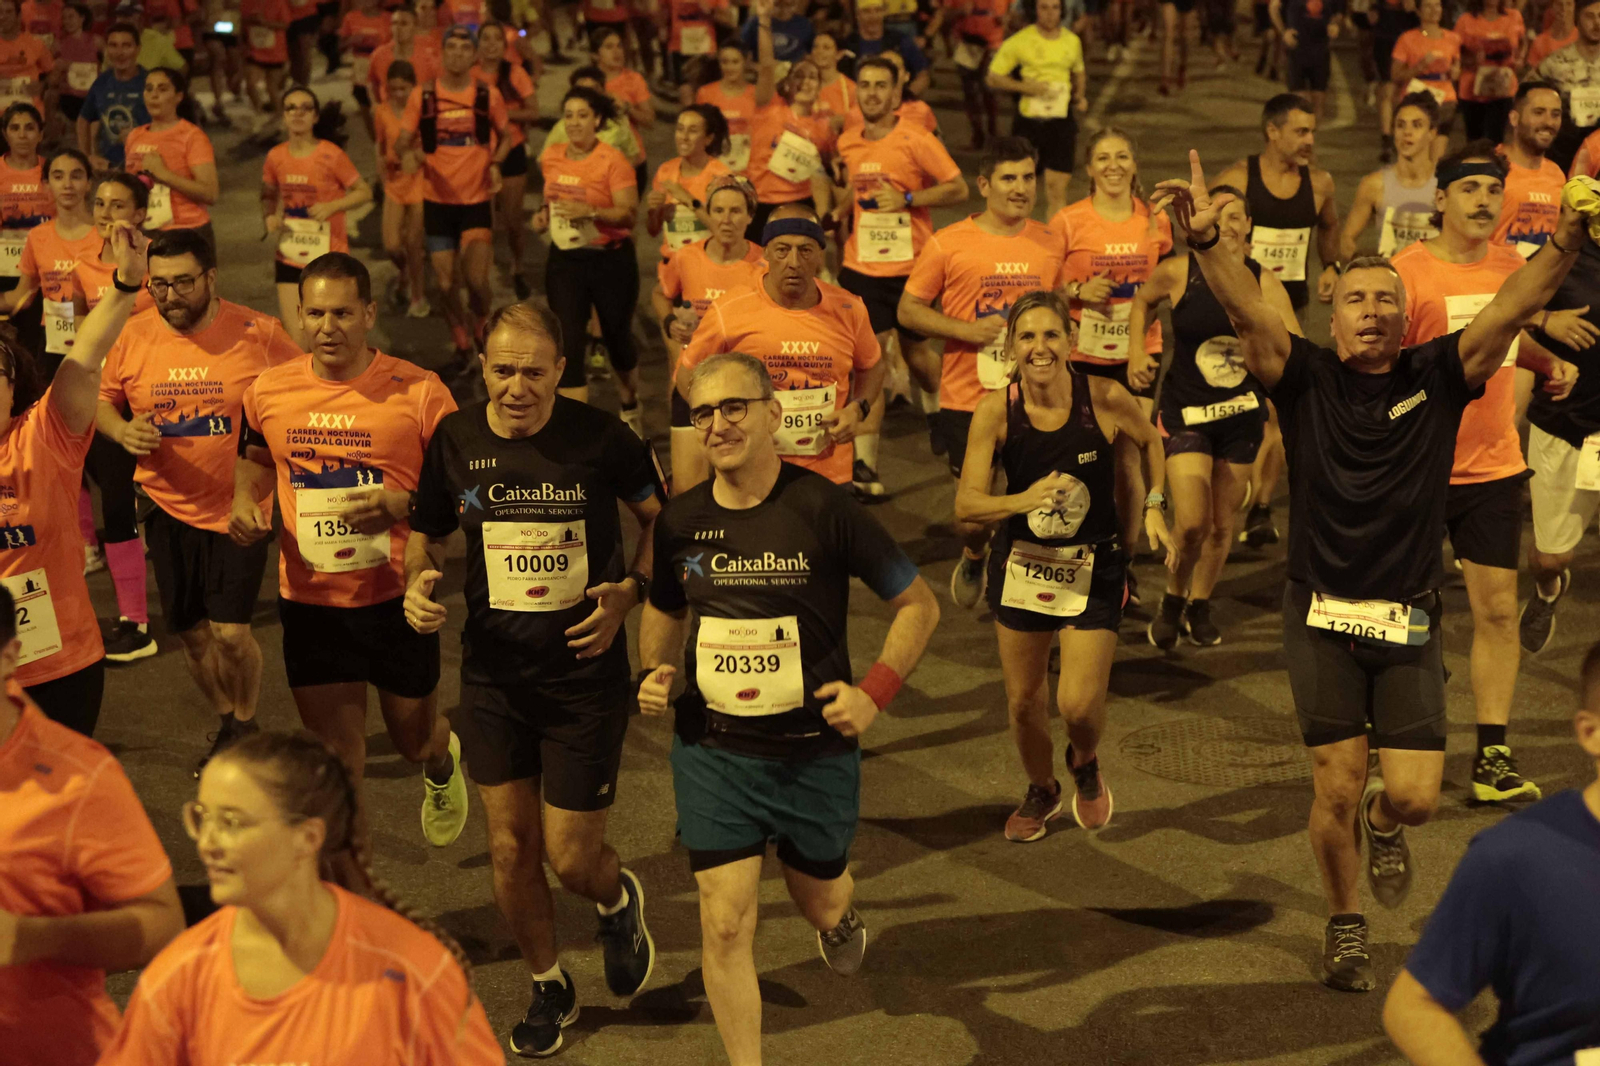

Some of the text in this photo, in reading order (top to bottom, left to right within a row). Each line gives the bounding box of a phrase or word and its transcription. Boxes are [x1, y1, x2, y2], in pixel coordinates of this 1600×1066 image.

[869, 230, 898, 241] 9526
[1104, 243, 1138, 255] XXXV
[1263, 247, 1299, 258] 14578
[995, 262, 1030, 274] XXXV
[781, 341, 820, 354] XXXV
[768, 361, 833, 369] GUADALQUIVIR
[168, 367, 209, 381] XXXV
[155, 387, 224, 397] GUADALQUIVIR
[1201, 404, 1246, 418] 11535
[307, 411, 356, 430] XXXV
[784, 412, 823, 429] 9619
[286, 428, 372, 439] CARRERA NOCTURNA
[292, 435, 372, 448] GUADALQUIVIR
[1077, 450, 1098, 465] CRIS
[469, 458, 497, 471] GOBIK
[488, 482, 588, 502] CaixaBank
[495, 506, 584, 517] OPERATIONAL SERVICES
[694, 529, 725, 541] GOBIK
[504, 554, 569, 573] 10009
[711, 551, 811, 573] CaixaBank
[1023, 562, 1077, 584] 12063
[713, 577, 808, 586] OPERATIONAL SERVICES
[1327, 619, 1387, 640] 12061
[714, 654, 780, 674] 20339
